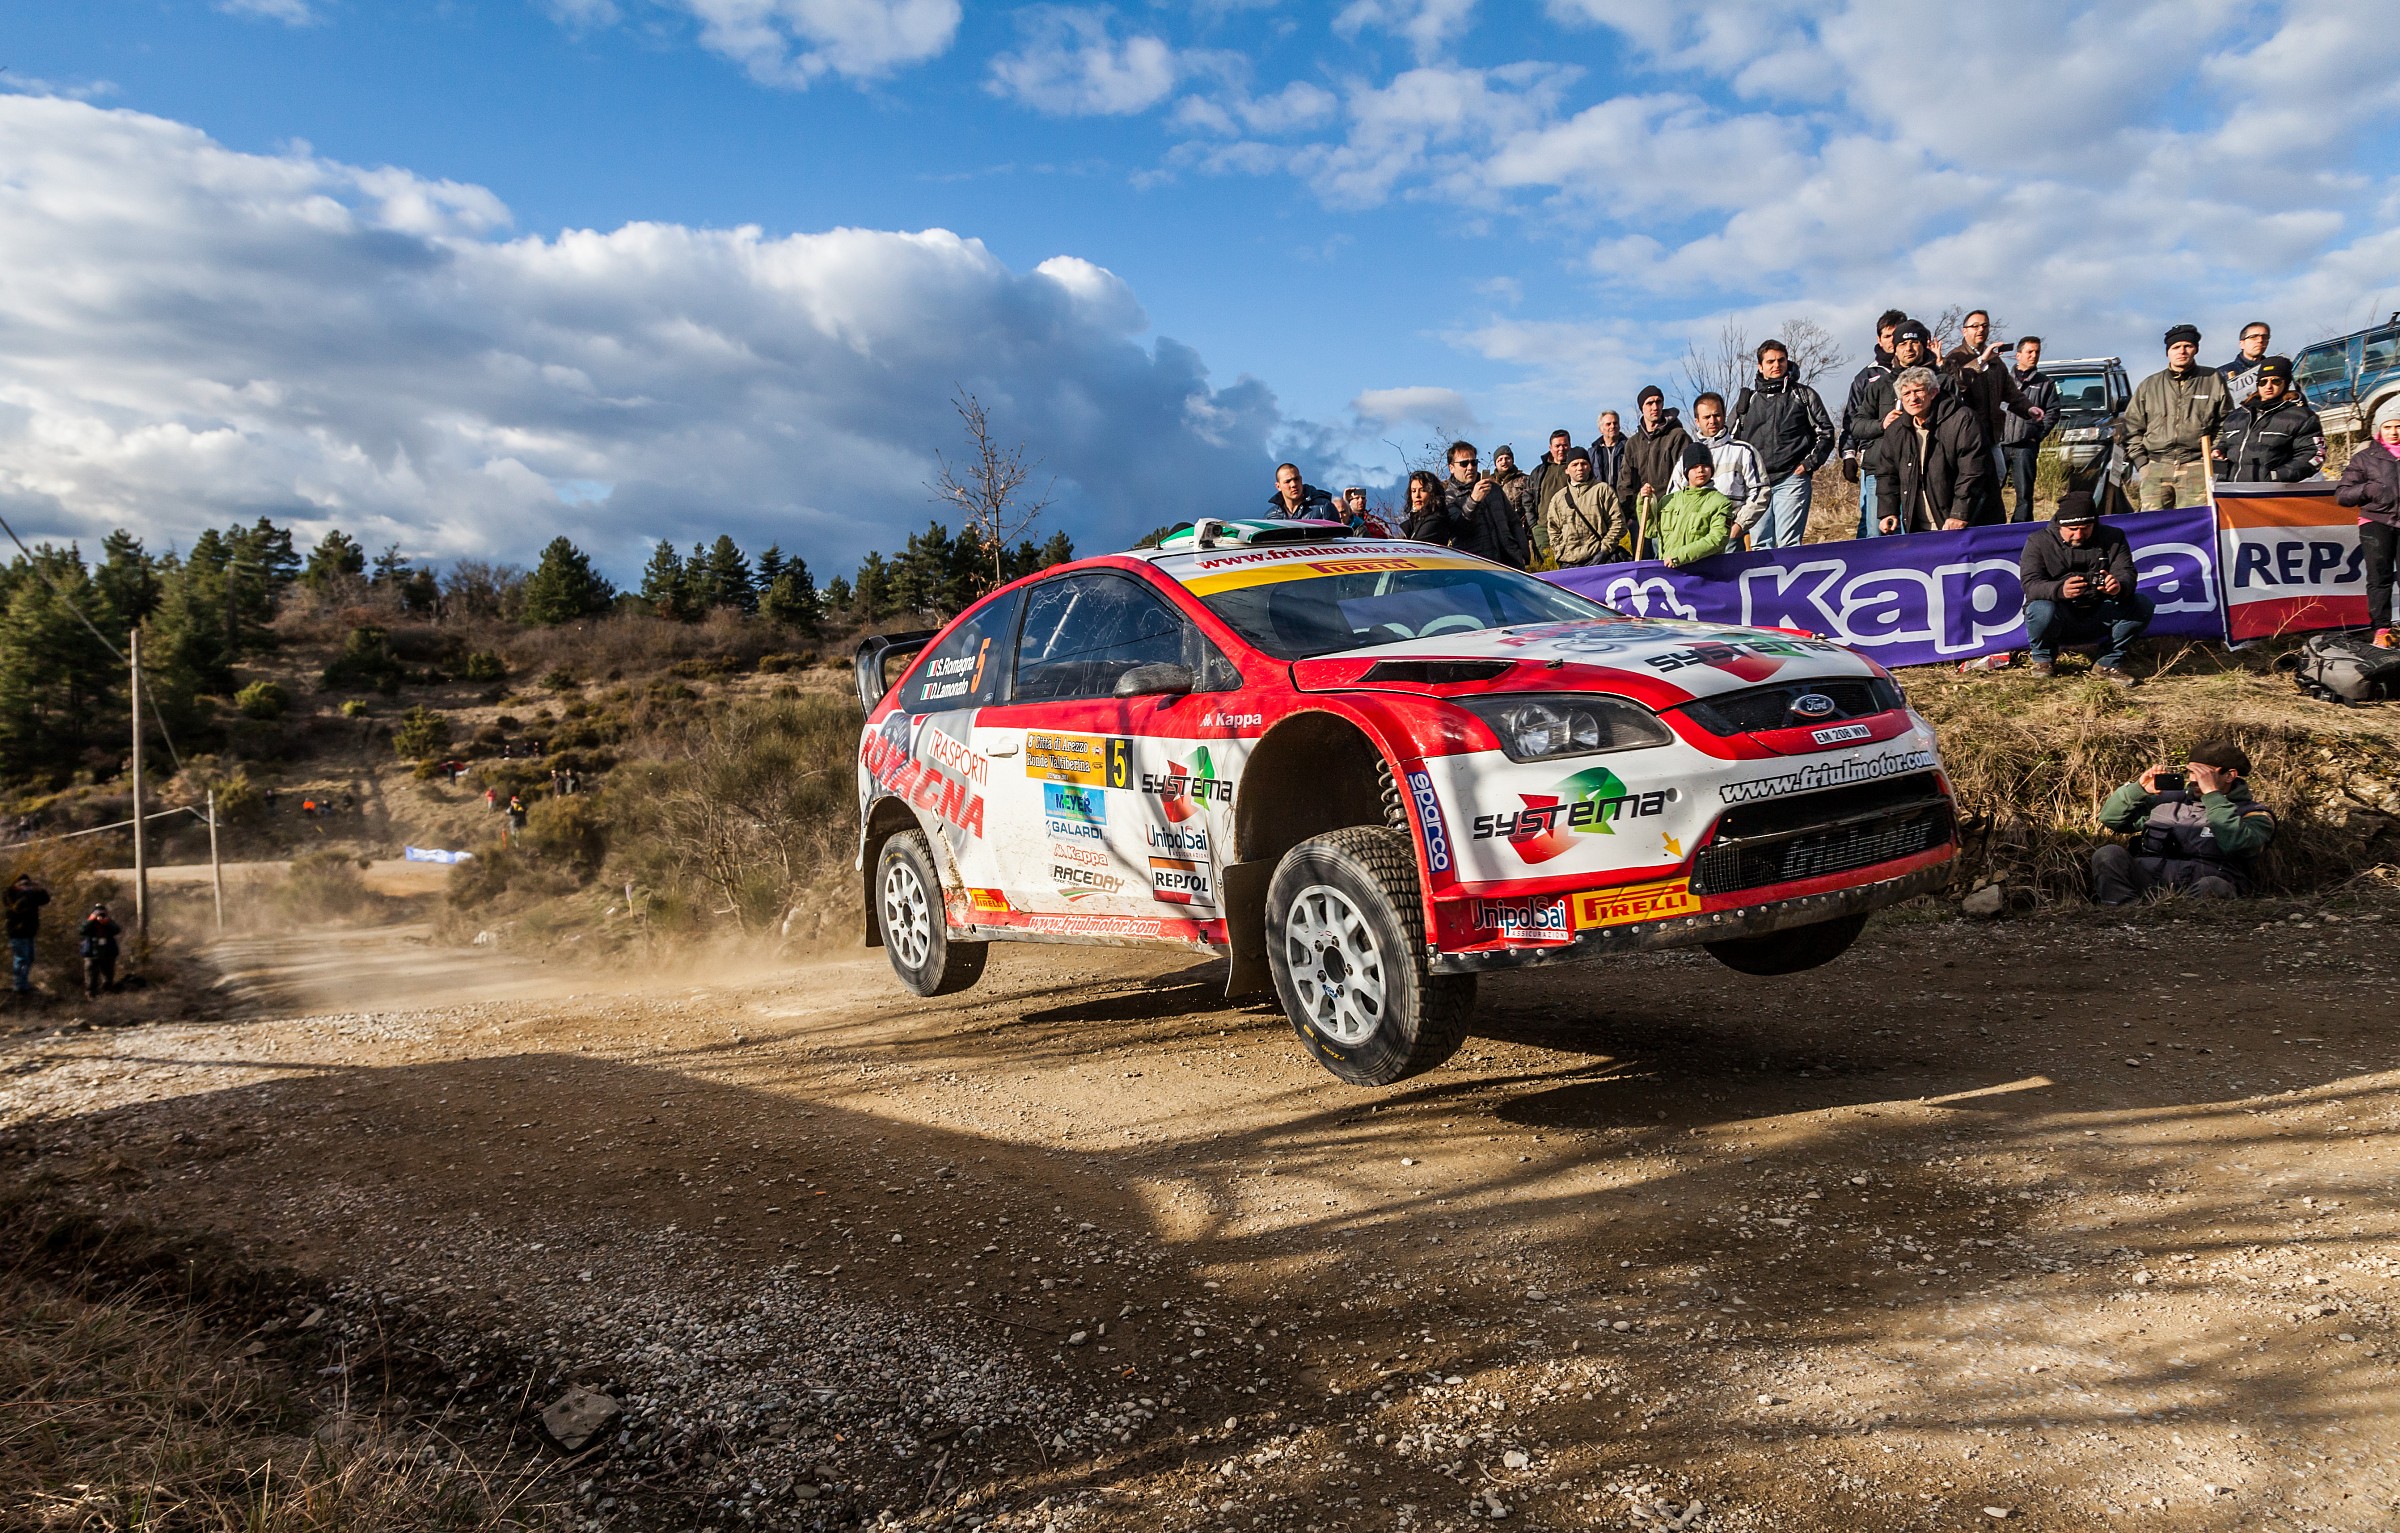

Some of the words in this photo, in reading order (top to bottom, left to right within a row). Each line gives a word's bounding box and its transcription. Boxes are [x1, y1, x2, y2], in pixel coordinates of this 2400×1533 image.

[1196, 546, 1442, 570] www.friulmotor.com
[1306, 558, 1419, 574] PIRELLI
[2234, 541, 2367, 588] REPS
[1739, 541, 2217, 655] Kapa
[970, 637, 992, 694] 5
[1806, 699, 1828, 711] Ford
[1215, 712, 1262, 728] Kappa
[1054, 736, 1061, 751] di
[1062, 738, 1088, 754] Arezzo
[1816, 731, 1831, 744] EM
[1834, 727, 1851, 740] 208
[1853, 725, 1871, 738] WM
[929, 729, 988, 787] TRASPORTI
[1027, 753, 1048, 769] Ronde
[1113, 739, 1126, 788] 5
[860, 728, 985, 840] ROMAGNA
[1719, 751, 1936, 803] www.friulmotor.com
[1055, 793, 1093, 814] MEYER
[1052, 821, 1103, 840] GALARDI
[1410, 773, 1450, 871] sparco
[1145, 823, 1208, 855] UnipolSai
[1066, 845, 1109, 867] Kappa
[1053, 865, 1125, 894] RACEDAY
[1155, 872, 1209, 892] REPSOL
[974, 894, 1004, 908] PIRELLI
[1584, 884, 1687, 921] PIRELLI
[1029, 915, 1161, 935] www.friulmotor.com
[1470, 897, 1566, 936] UnipolSai
